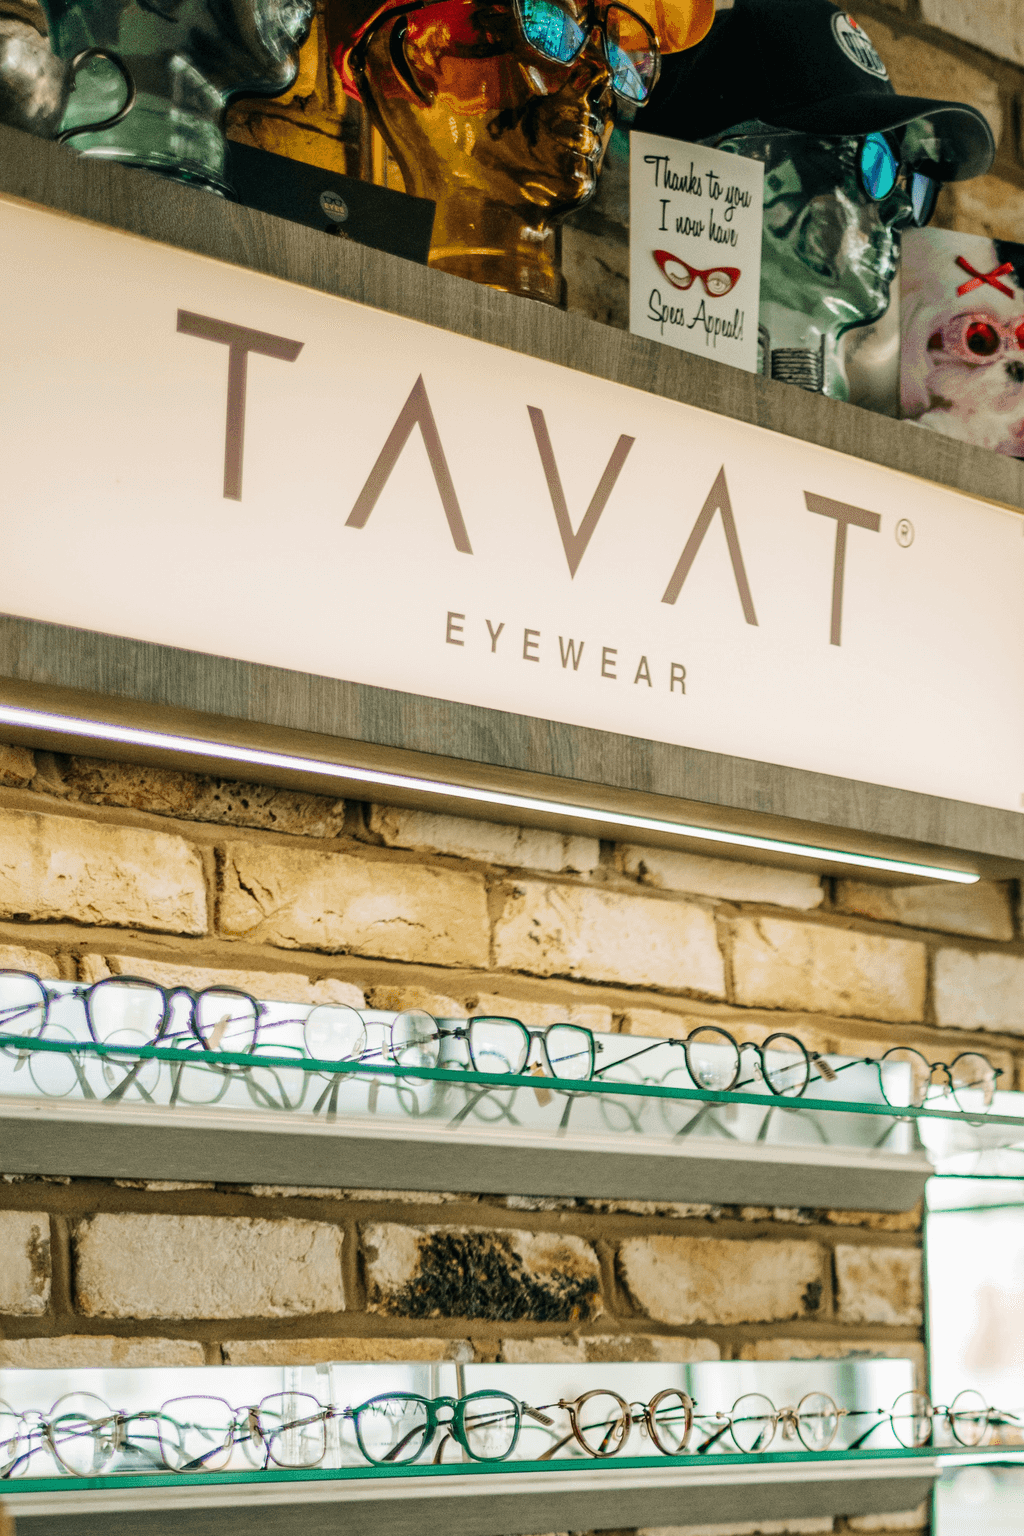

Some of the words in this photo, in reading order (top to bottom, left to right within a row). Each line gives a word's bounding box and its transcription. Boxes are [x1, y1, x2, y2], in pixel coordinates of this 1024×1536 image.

[644, 155, 703, 197] Thanks
[705, 170, 723, 201] to
[725, 185, 752, 222] you
[658, 199, 671, 232] I
[676, 215, 705, 238] now
[708, 208, 738, 247] have
[647, 288, 686, 336] Specs
[686, 299, 745, 348] Appeal!
[445, 610, 689, 697] EYEWEAR
